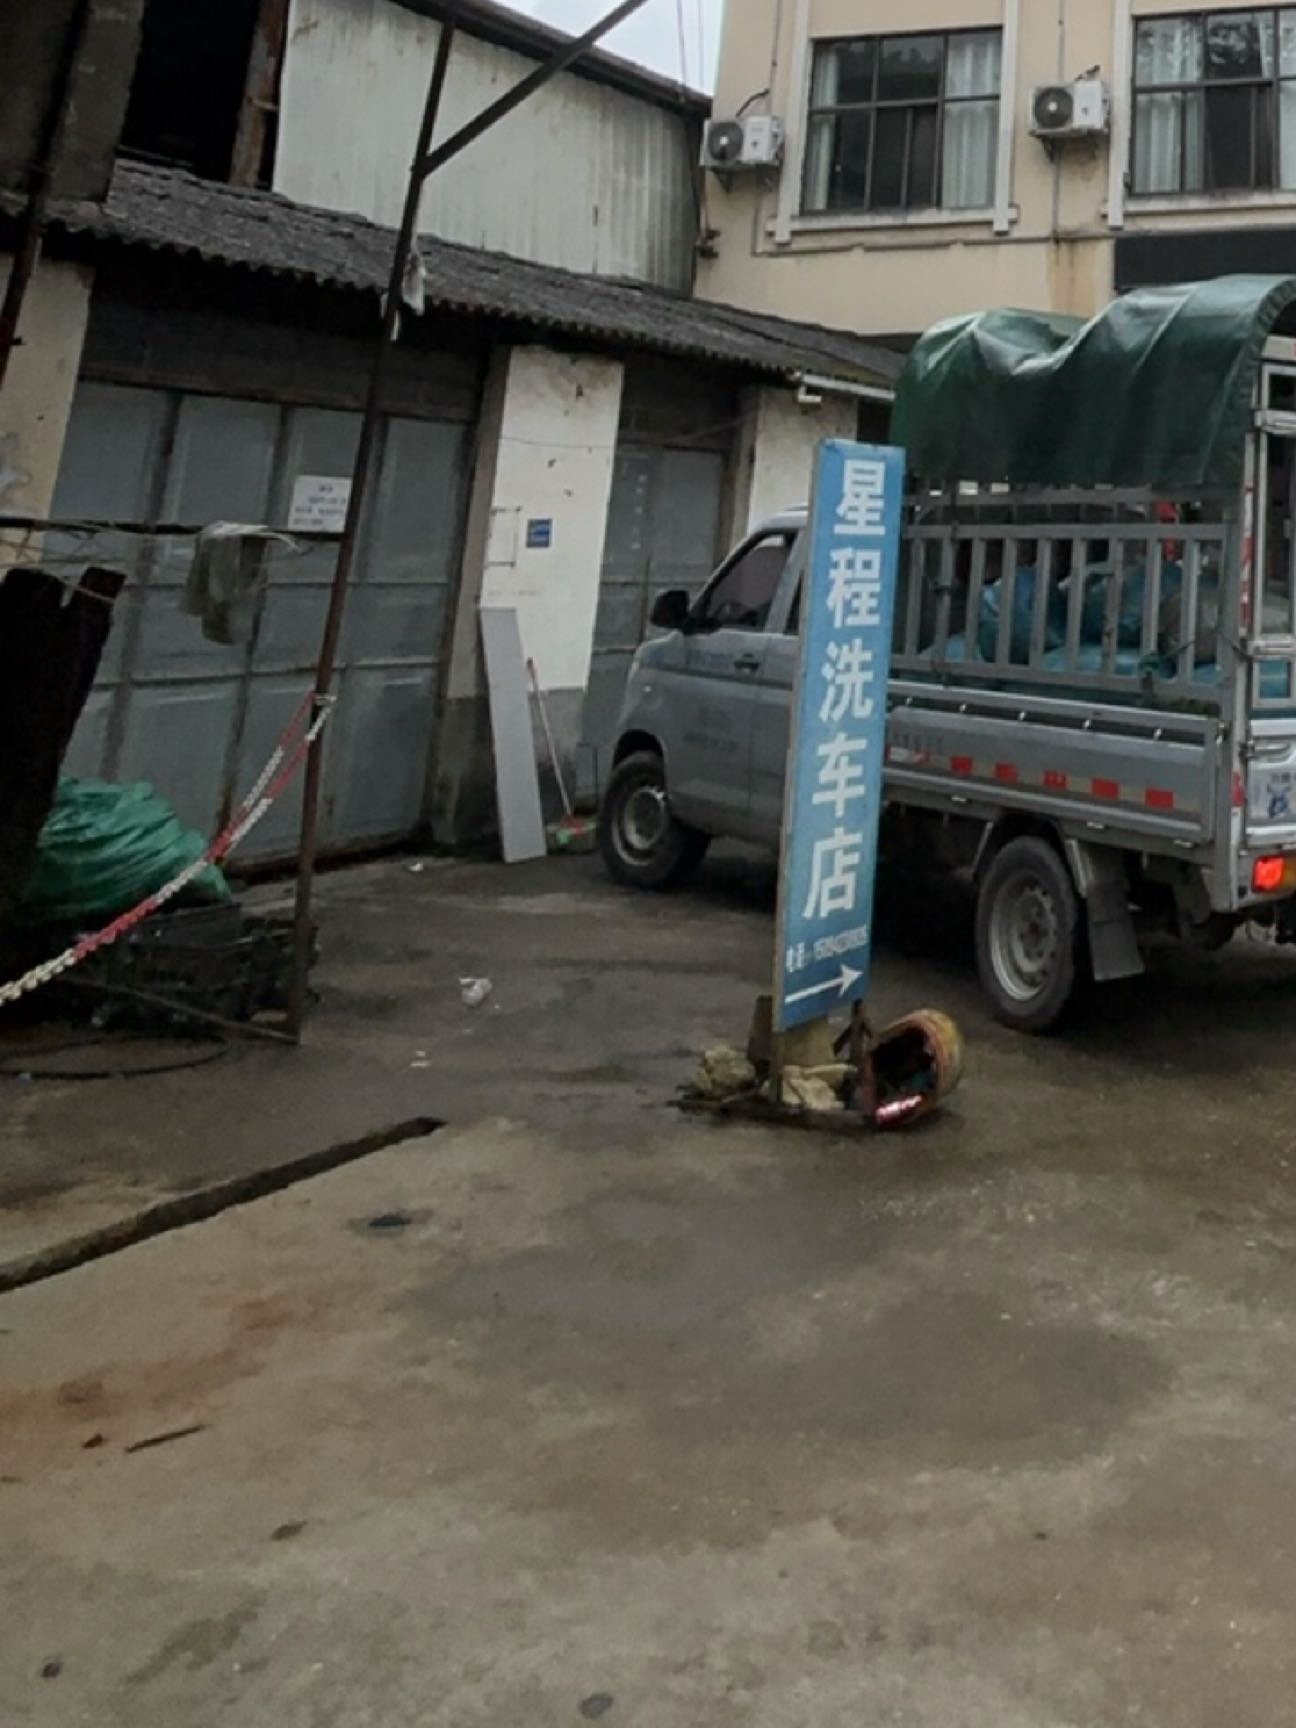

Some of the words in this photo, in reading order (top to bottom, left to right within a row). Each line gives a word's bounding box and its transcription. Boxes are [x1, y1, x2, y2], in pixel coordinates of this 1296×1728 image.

[802, 457, 888, 921] 星程洗车店
